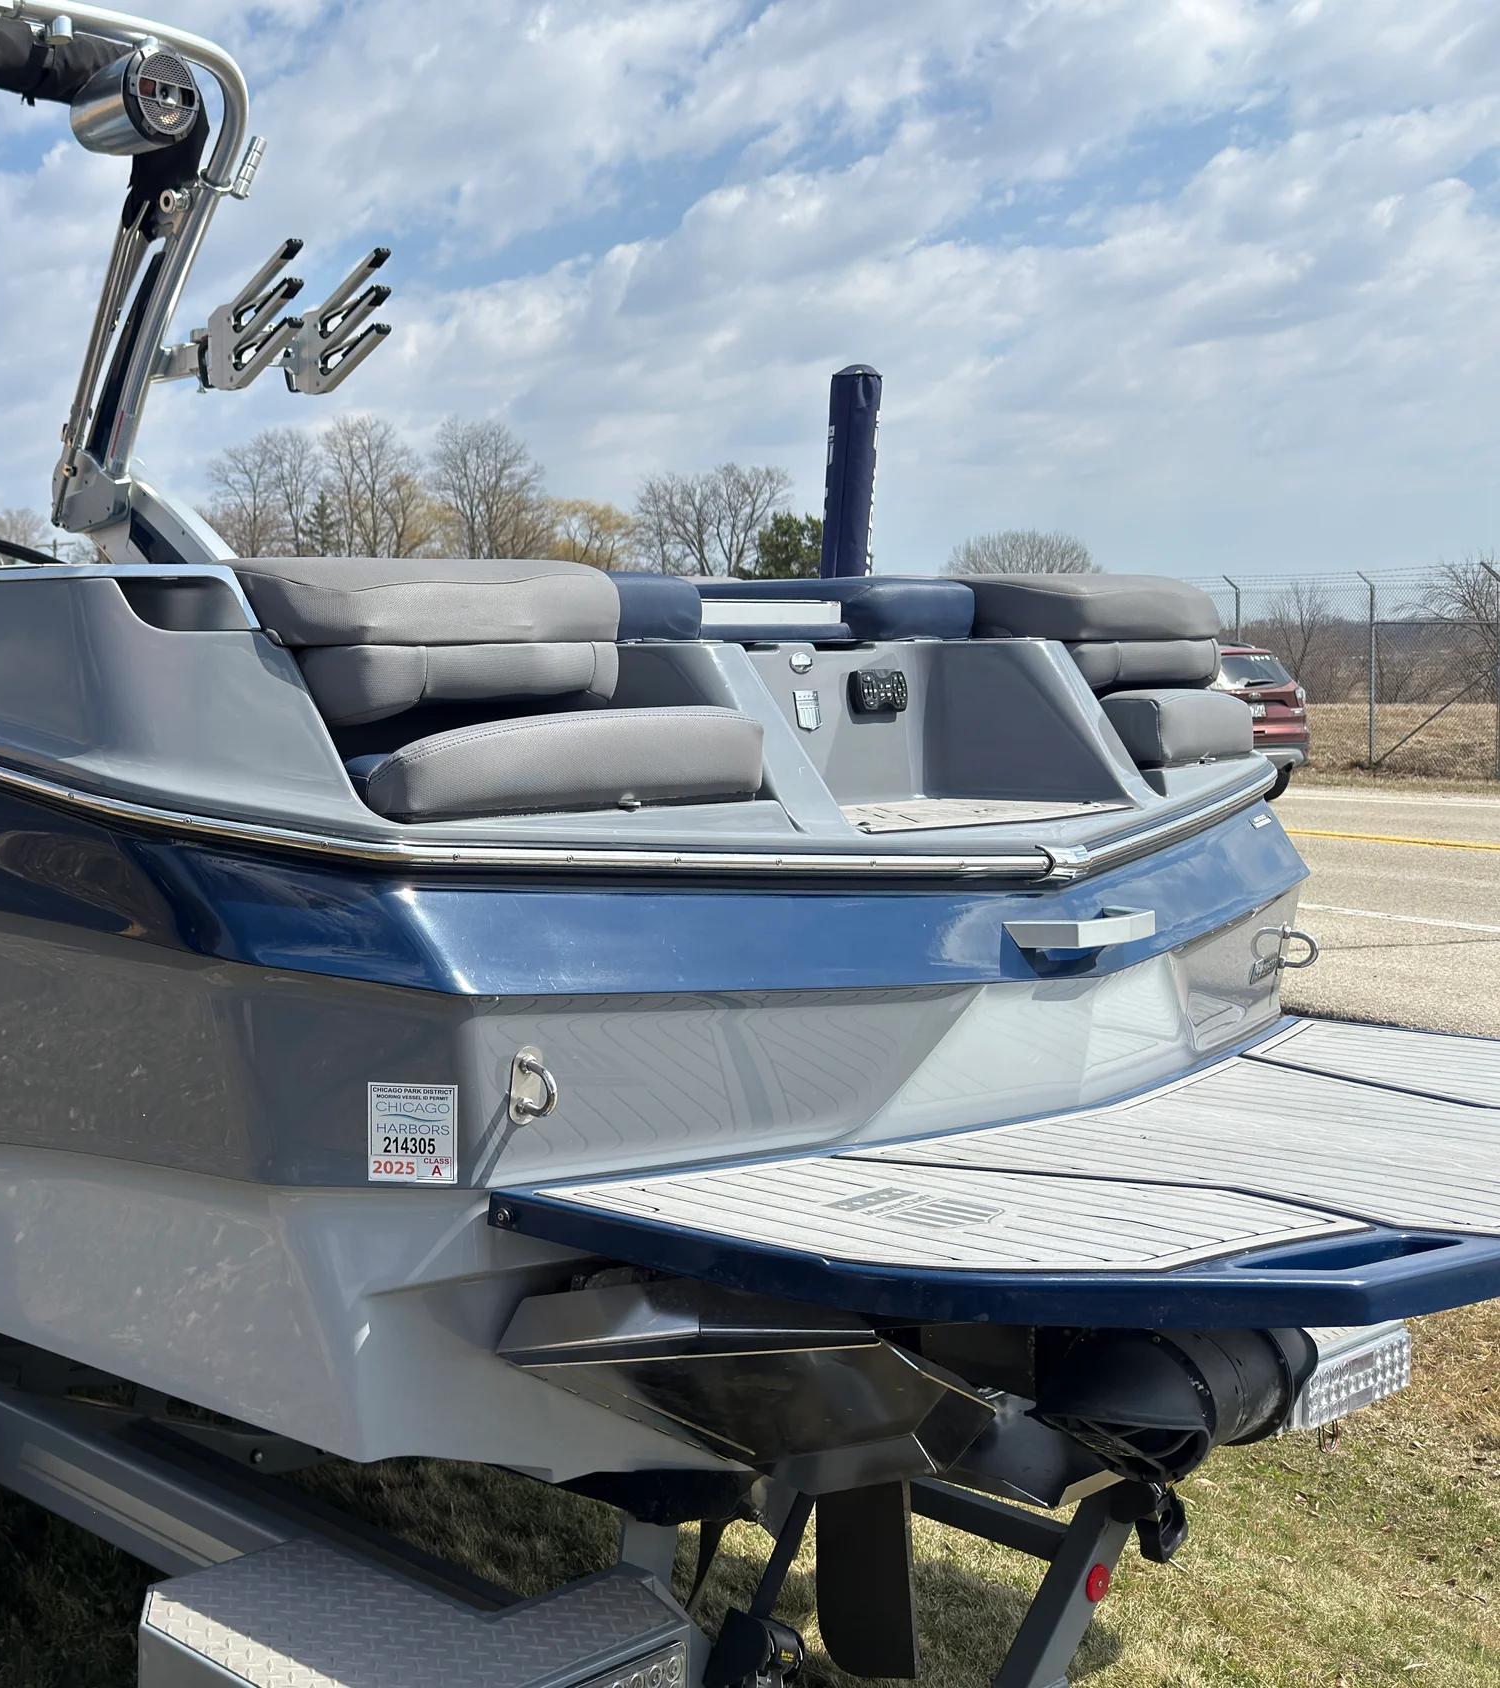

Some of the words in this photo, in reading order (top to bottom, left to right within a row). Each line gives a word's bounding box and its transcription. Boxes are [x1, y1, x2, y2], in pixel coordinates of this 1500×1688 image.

[375, 1101, 450, 1114] CHICAGO
[376, 1123, 450, 1136] HARBORS
[383, 1136, 436, 1155] 214305
[372, 1160, 415, 1175] 2025
[423, 1157, 450, 1165] CLASS
[431, 1165, 442, 1176] A
